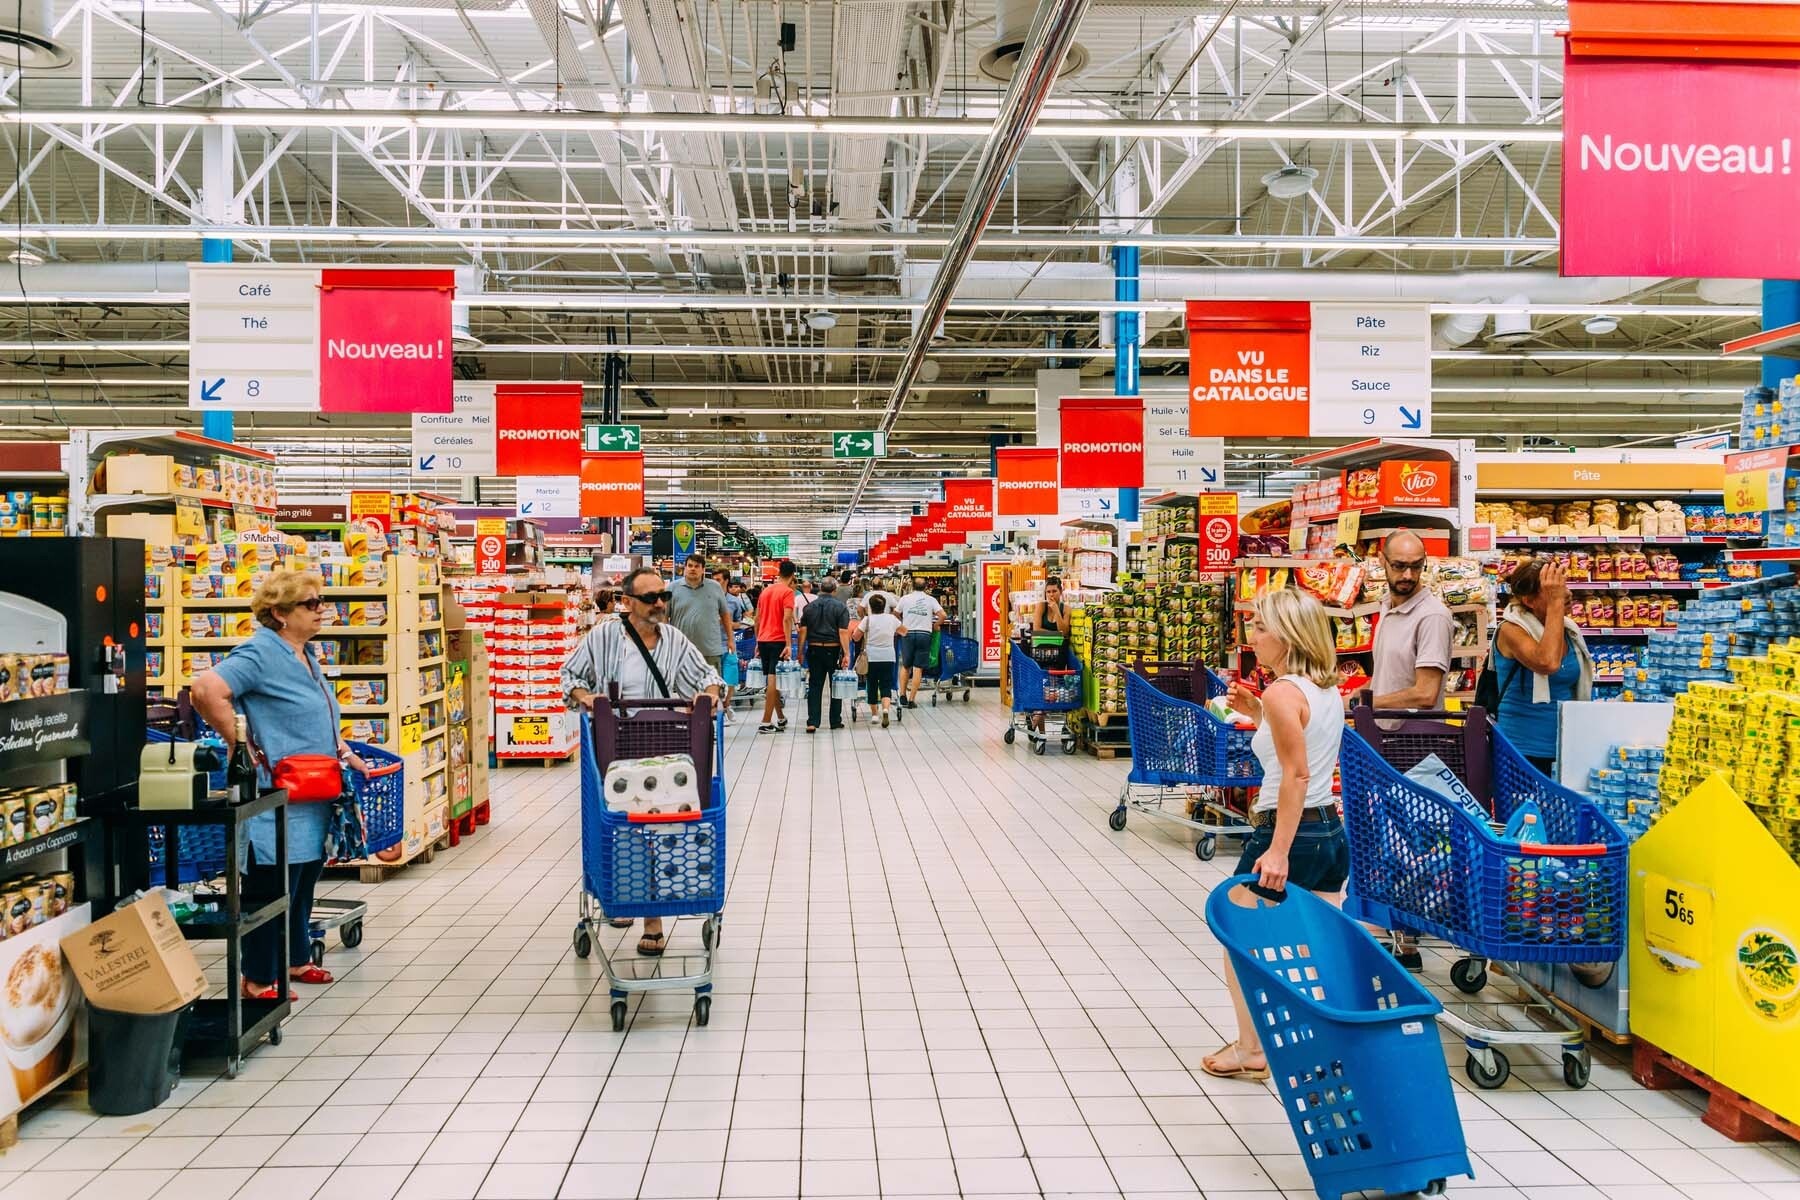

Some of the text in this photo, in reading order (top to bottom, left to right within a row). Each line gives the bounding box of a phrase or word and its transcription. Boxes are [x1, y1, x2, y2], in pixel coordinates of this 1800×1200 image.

[239, 284, 272, 296] Café
[241, 317, 268, 329] Thé
[1356, 316, 1386, 328] Pâte
[1361, 345, 1380, 357] Riz
[1237, 350, 1264, 366] VU
[1209, 368, 1289, 383] DANS LE
[247, 380, 260, 397] 8
[1351, 379, 1390, 391] Sauce
[453, 394, 473, 403] otte
[1192, 385, 1308, 401] CATALOGUE
[1151, 407, 1173, 415] Huile
[1363, 408, 1375, 424] 9
[420, 414, 490, 424] Confiture Miel
[499, 429, 580, 440] PROMOTION
[1159, 428, 1172, 436] Sel
[433, 436, 473, 446] Céréales
[1063, 442, 1142, 453] PROMOTION
[1172, 448, 1194, 457] Huile
[447, 457, 462, 469] 10
[1176, 469, 1187, 481] 11
[1573, 469, 1601, 481] Pâte
[581, 482, 642, 491] PROMOTION
[999, 481, 1057, 489] PROMOTION
[1406, 474, 1435, 491] Vico
[541, 502, 552, 512] 12
[1080, 500, 1090, 508] 13
[291, 508, 312, 519] grillé
[1206, 548, 1231, 561] 500
[481, 559, 501, 570] 500
[83, 946, 149, 982] VALESTREL
